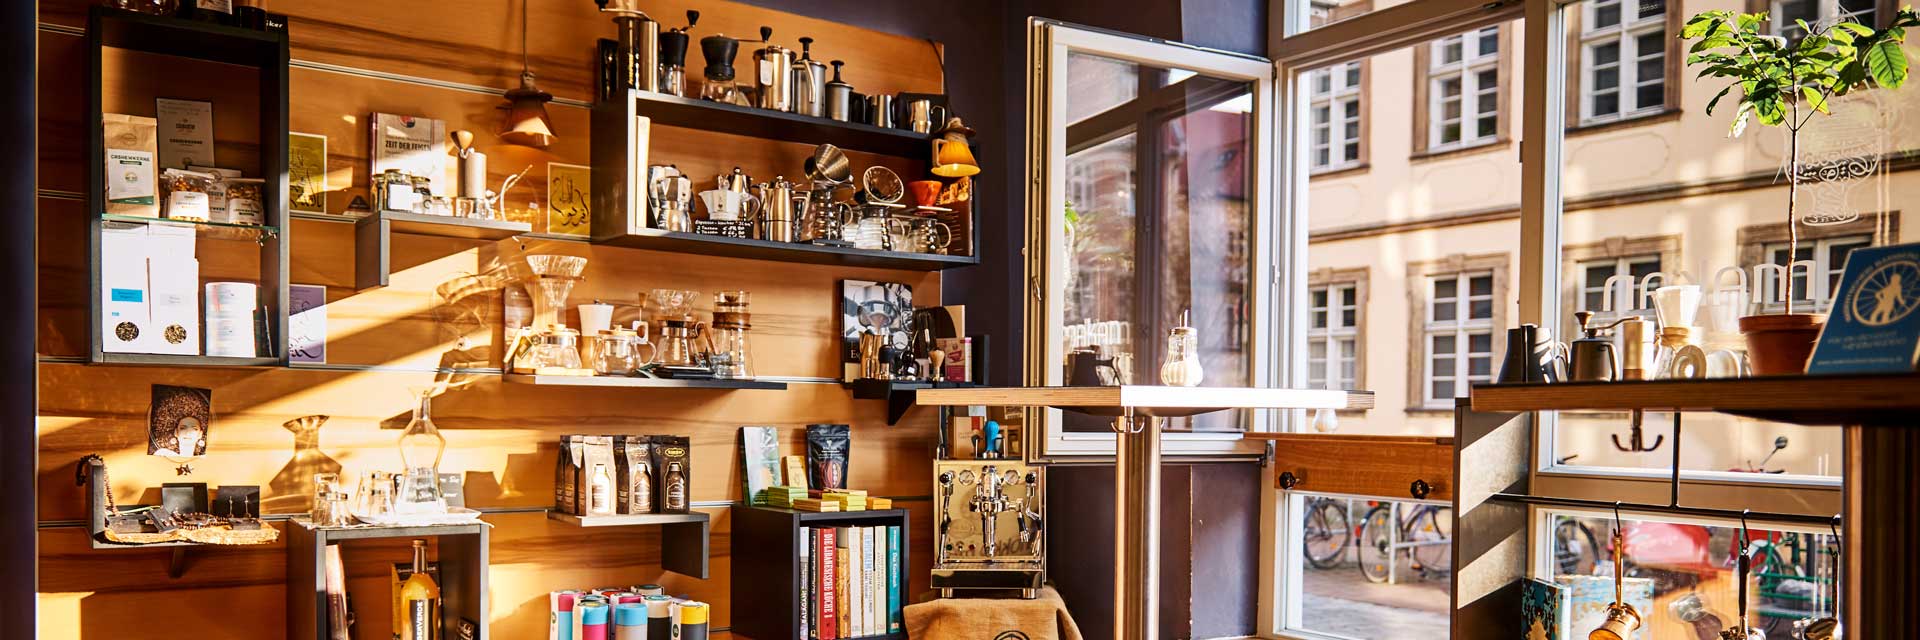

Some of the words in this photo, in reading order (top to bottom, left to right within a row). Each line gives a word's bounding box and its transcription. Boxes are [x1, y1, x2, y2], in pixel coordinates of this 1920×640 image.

[385, 140, 398, 149] ZEIT
[399, 142, 410, 150] DER
[824, 533, 833, 545] DIE
[824, 546, 833, 591] LIBANESISCHE
[824, 591, 834, 613] KÜCHE
